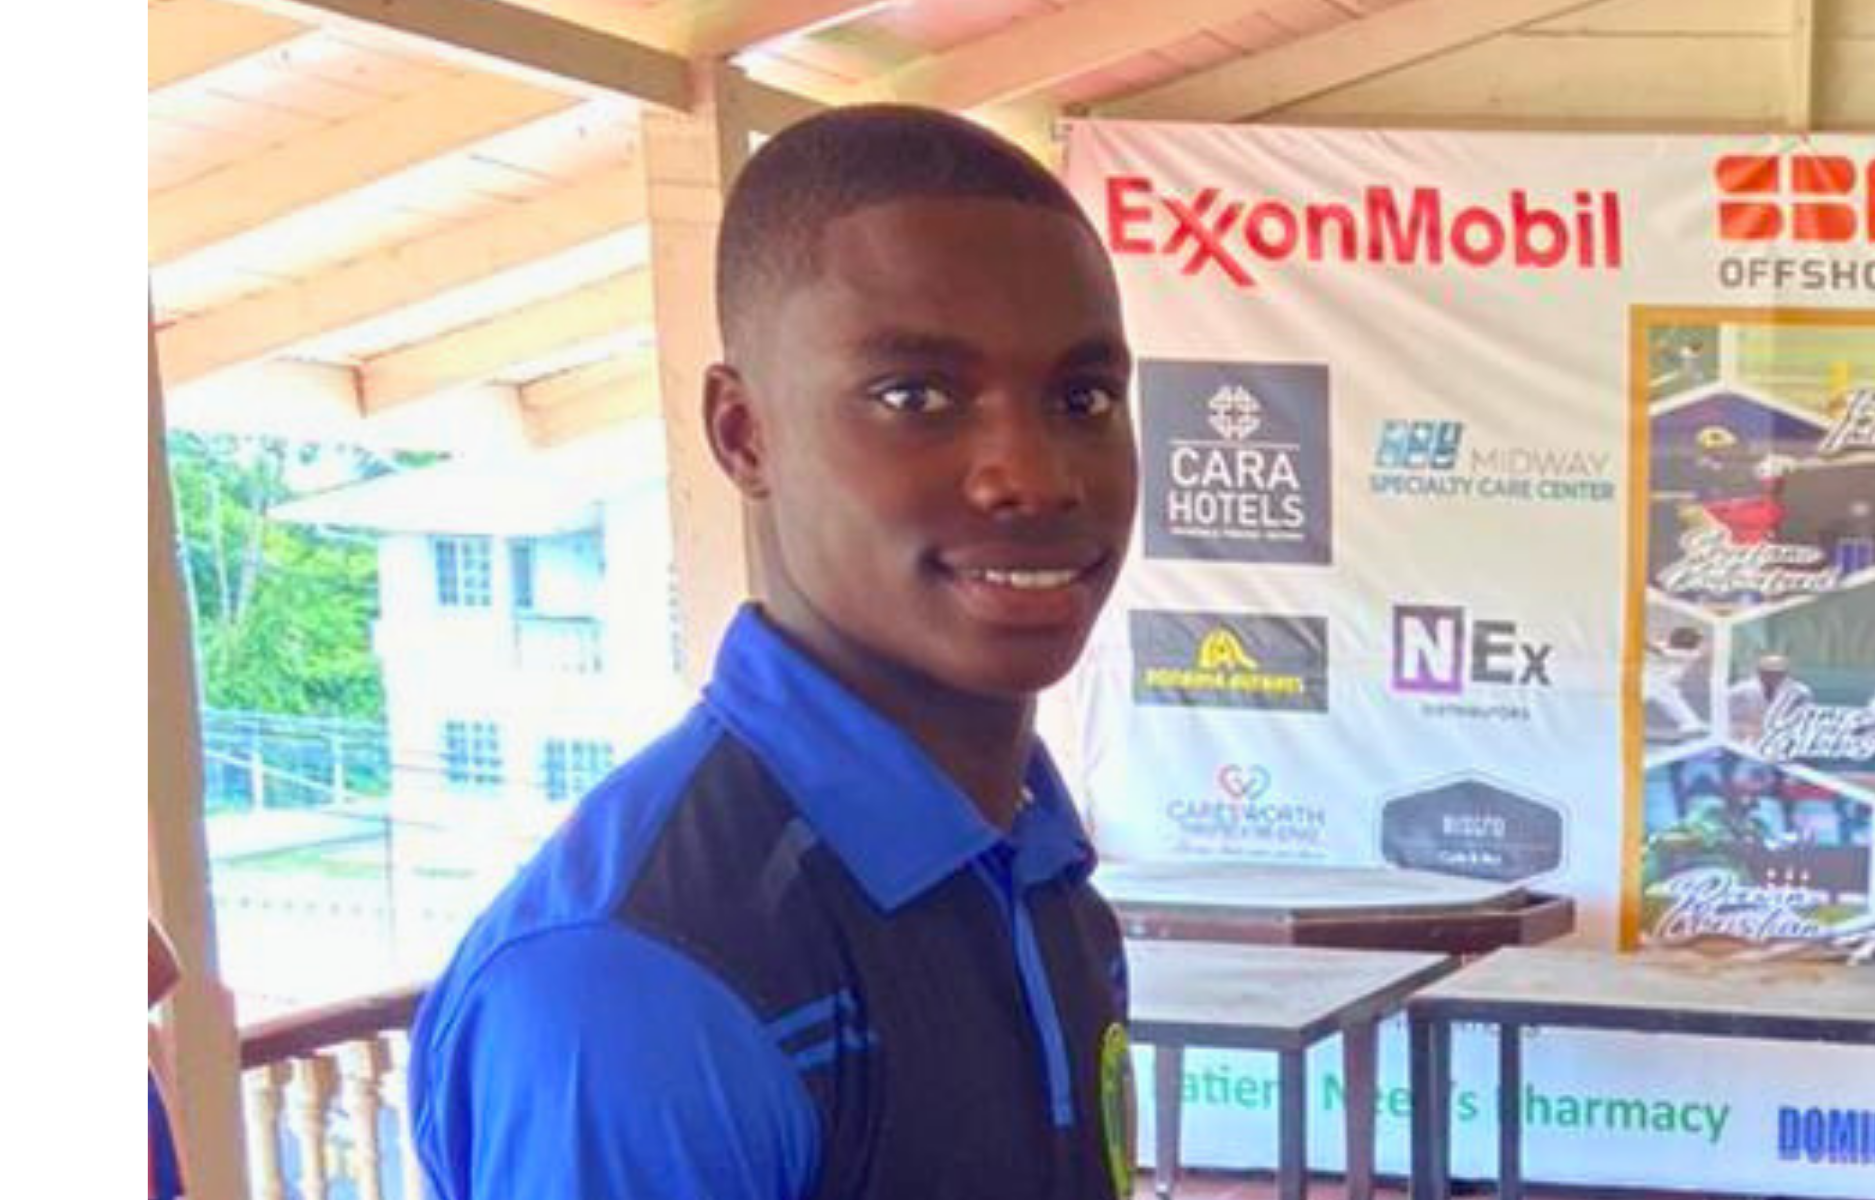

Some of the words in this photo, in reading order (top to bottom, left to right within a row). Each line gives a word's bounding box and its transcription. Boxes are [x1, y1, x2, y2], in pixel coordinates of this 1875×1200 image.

[1106, 176, 1622, 287] ExxonMobil
[1170, 446, 1301, 490] CARA
[1470, 448, 1609, 476] MIDWAY
[1167, 489, 1306, 528] HOTELS
[1370, 474, 1474, 497] SPECIALTY
[1477, 476, 1532, 499] CARE
[1534, 479, 1615, 502] CENTER
[1499, 1084, 1731, 1145] harmacy
